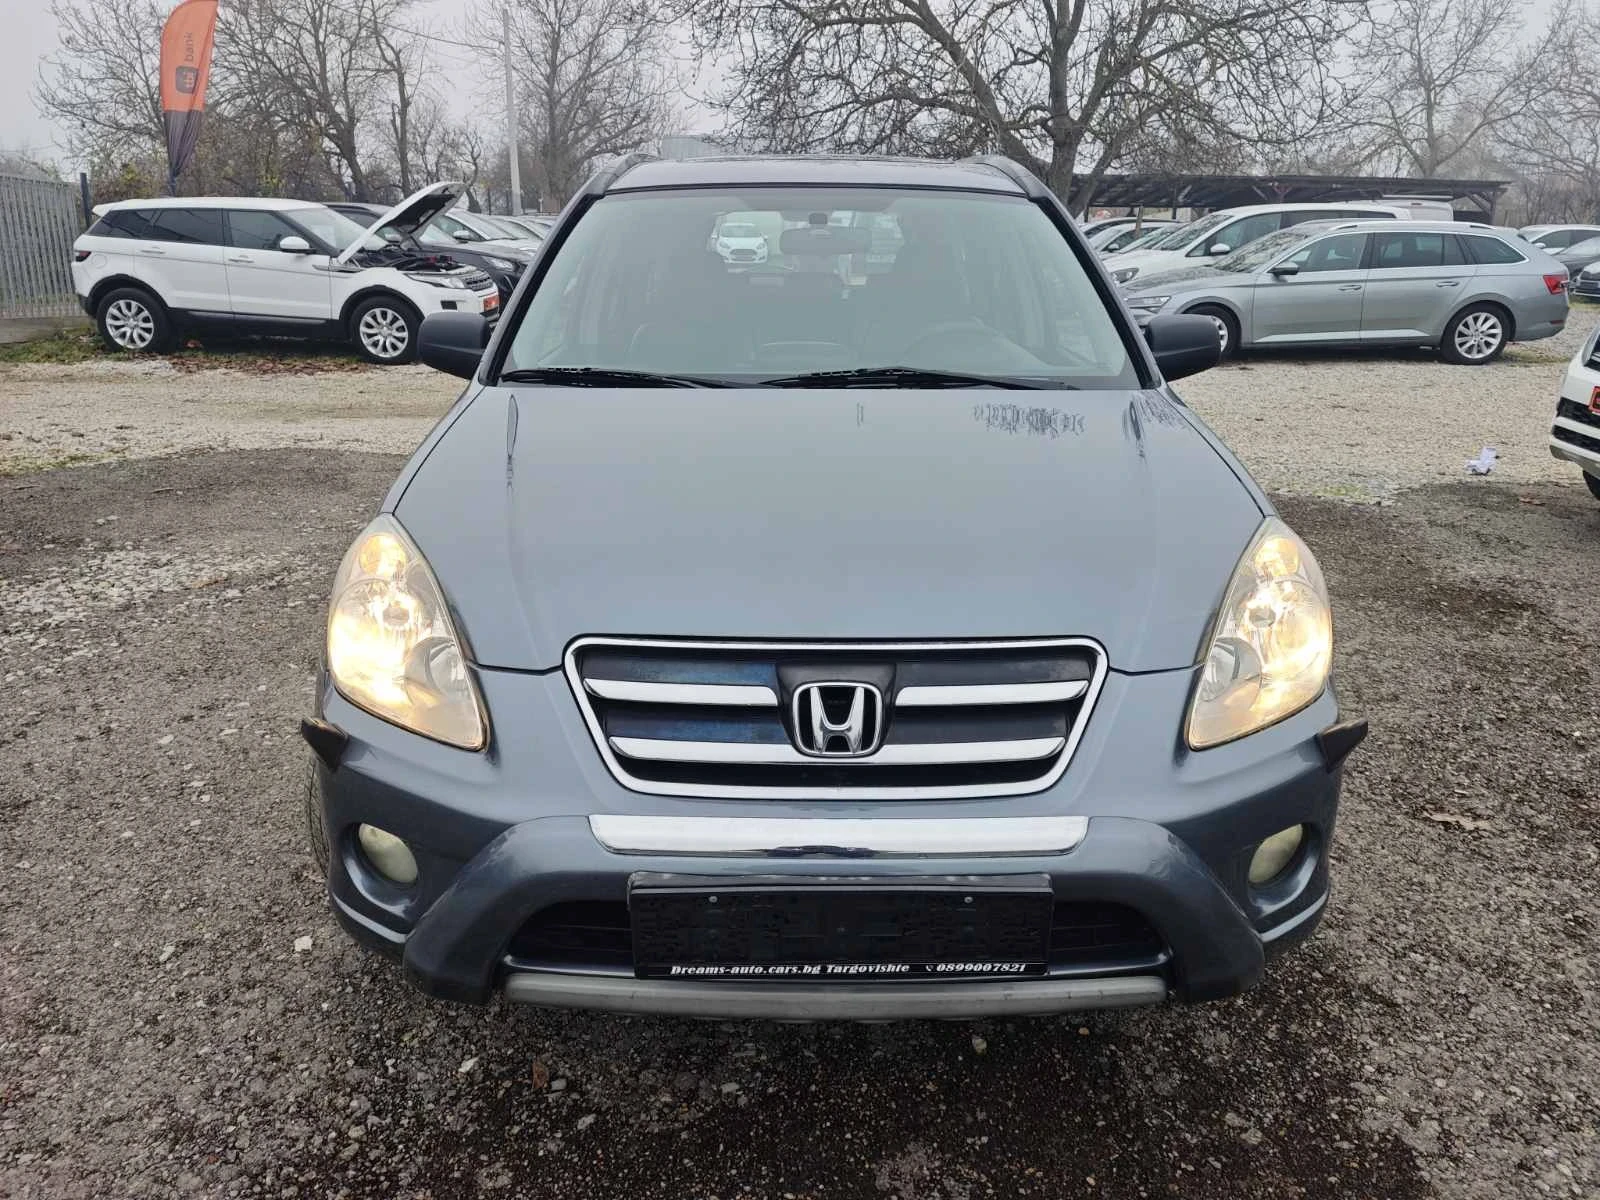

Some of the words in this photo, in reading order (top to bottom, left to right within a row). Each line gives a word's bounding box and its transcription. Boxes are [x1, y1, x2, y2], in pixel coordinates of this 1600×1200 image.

[184, 32, 194, 62] bank
[670, 964, 821, 975] Dreams-auto.cars.bg
[826, 963, 909, 974] Targovishte
[936, 963, 1026, 972] 0899007821
